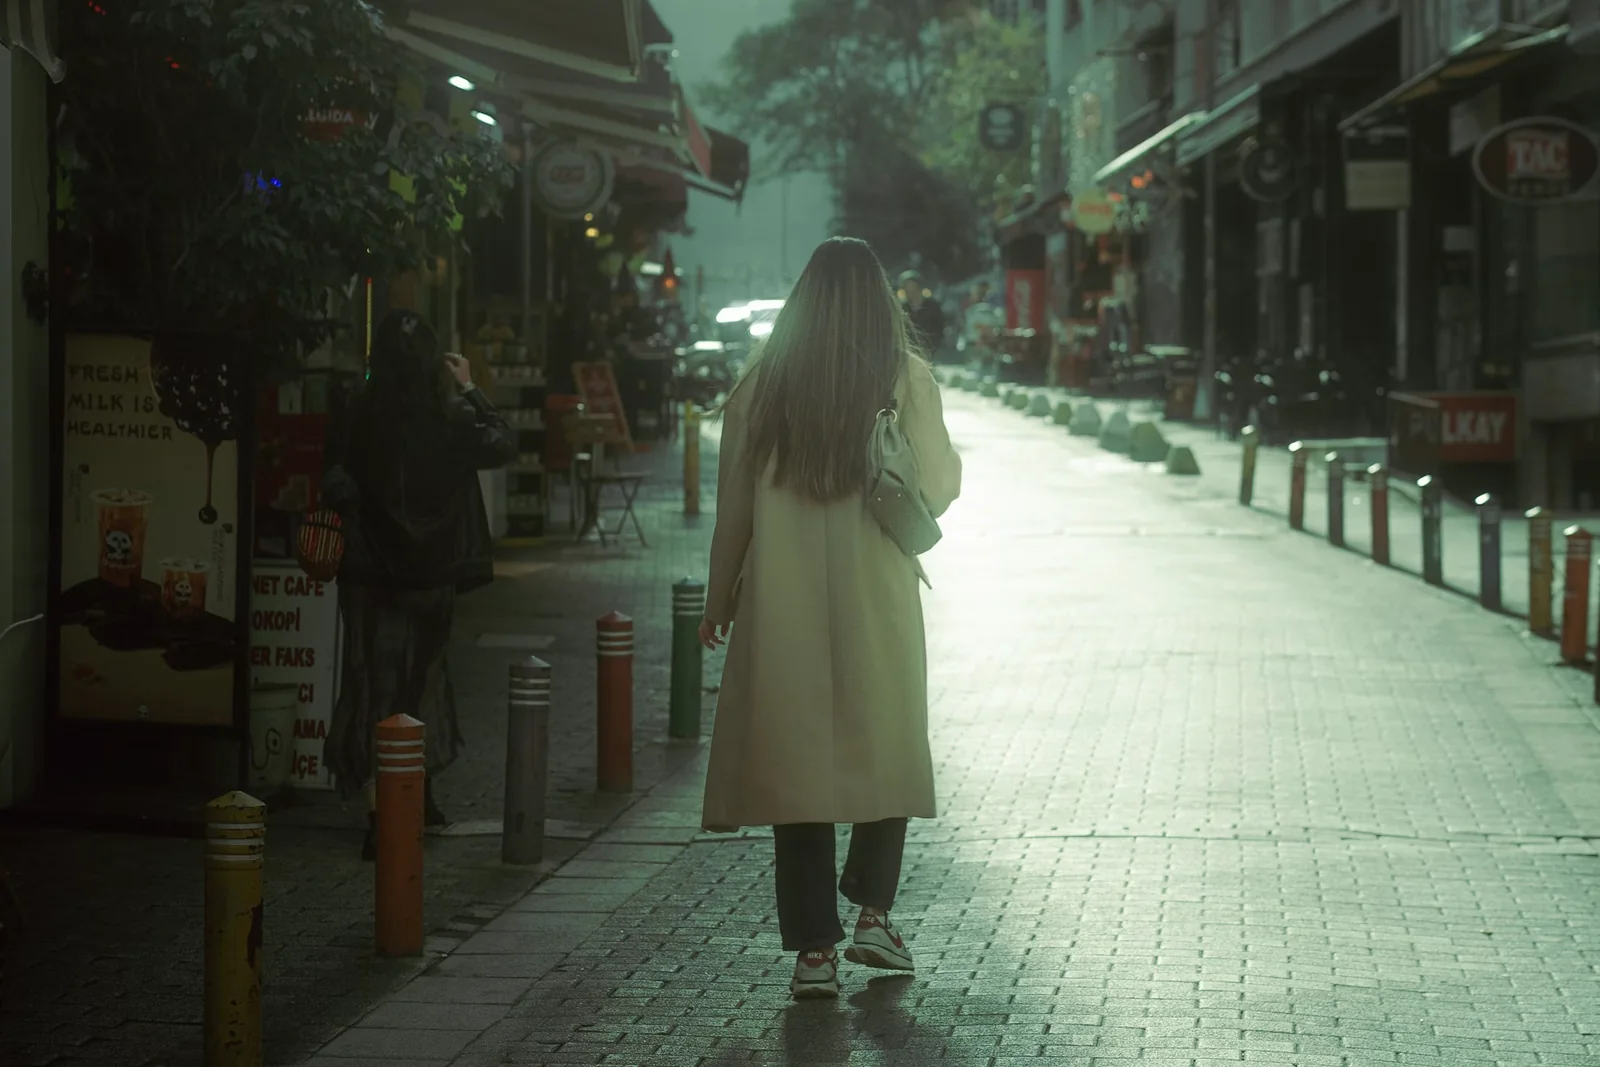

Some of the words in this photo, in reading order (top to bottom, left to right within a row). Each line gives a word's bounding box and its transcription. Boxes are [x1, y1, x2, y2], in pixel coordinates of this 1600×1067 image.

[68, 364, 139, 383] FRESH
[68, 393, 123, 413] MILK
[134, 395, 154, 413] IS
[67, 420, 173, 441] HEALTHIER
[284, 576, 324, 596] CAFE
[275, 647, 315, 668] FAKS
[807, 952, 823, 960] NIKE
